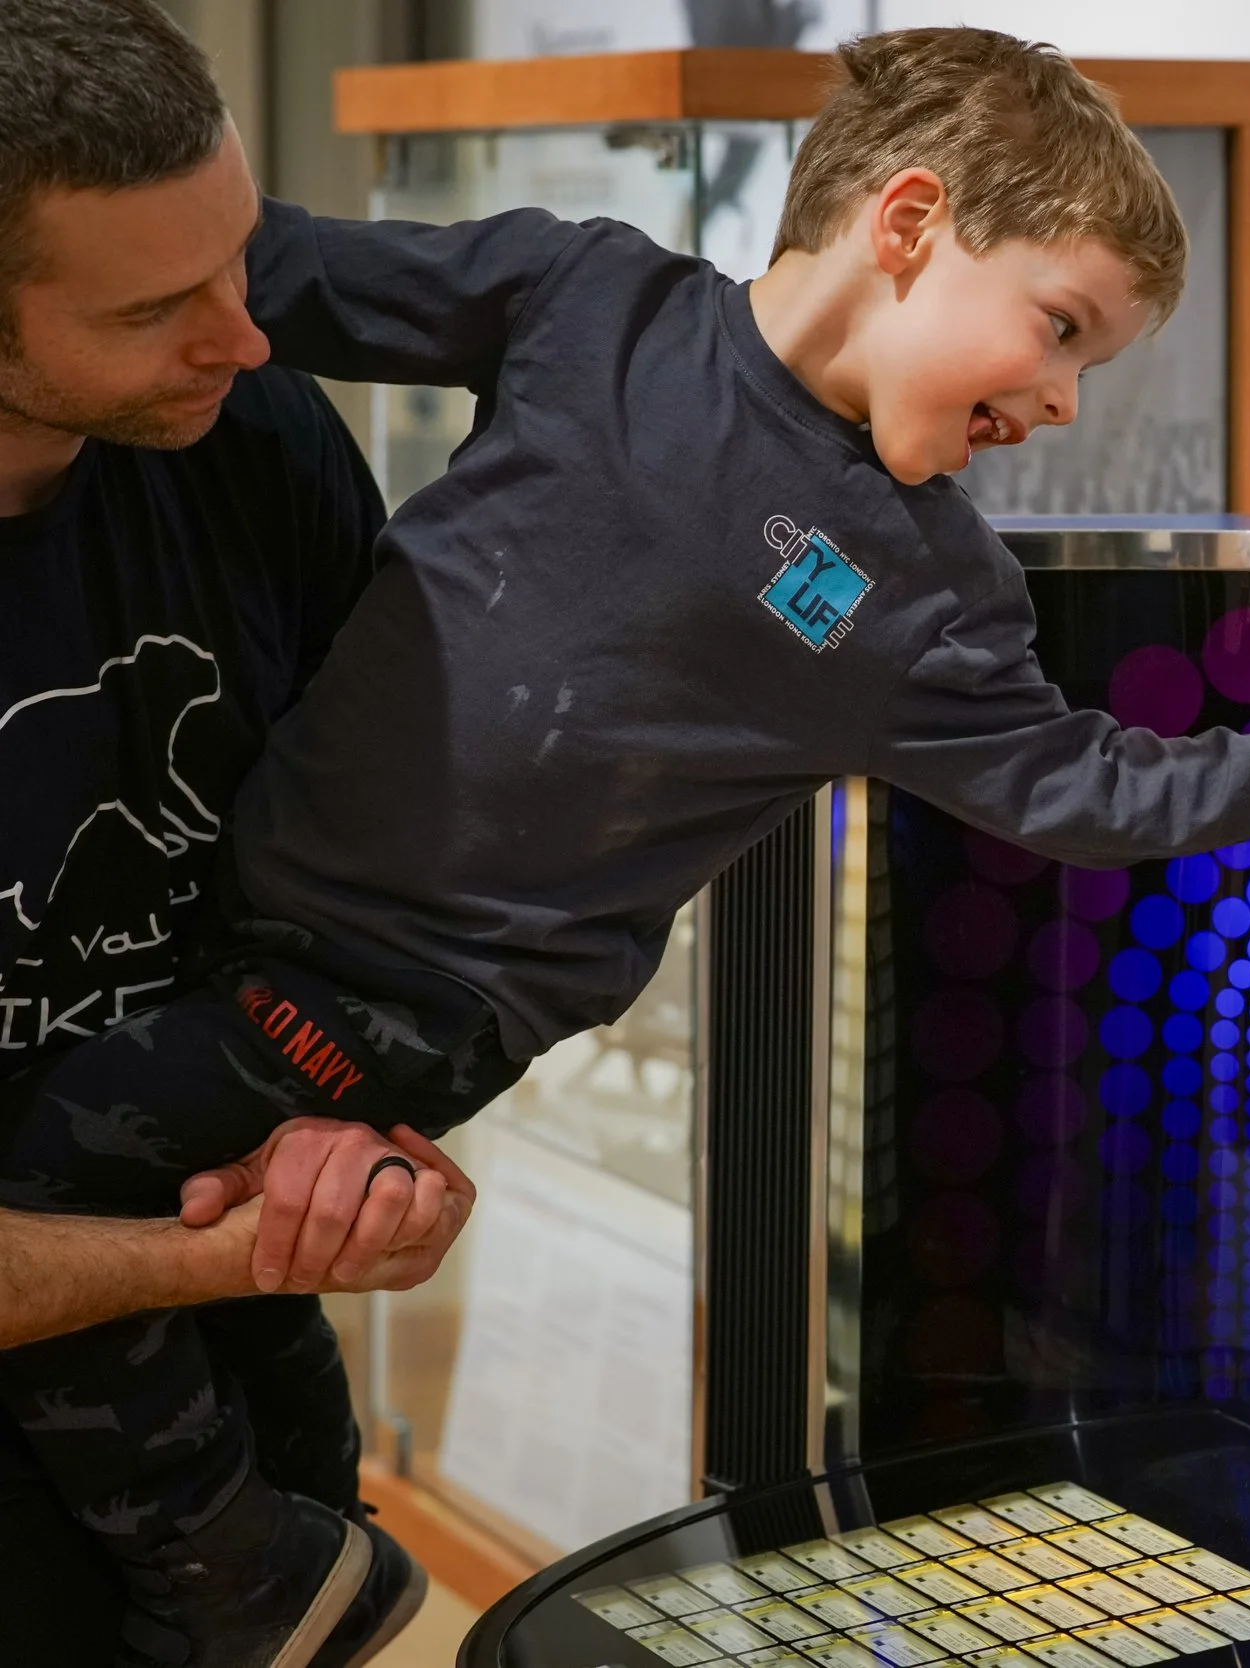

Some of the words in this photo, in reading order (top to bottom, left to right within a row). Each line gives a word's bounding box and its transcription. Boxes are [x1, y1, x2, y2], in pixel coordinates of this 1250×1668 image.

[764, 515, 836, 581] CITY
[770, 559, 791, 585] SYDNEY
[816, 529, 840, 553] TORONTO
[840, 551, 850, 564] NYC
[850, 561, 872, 583] LONDON
[760, 597, 784, 621] LONDON
[785, 620, 802, 637] HONG
[801, 635, 817, 651] KONG
[787, 582, 854, 649] LIFE
[846, 592, 866, 617] ANGELES
[282, 1019, 363, 1101] NAVY
